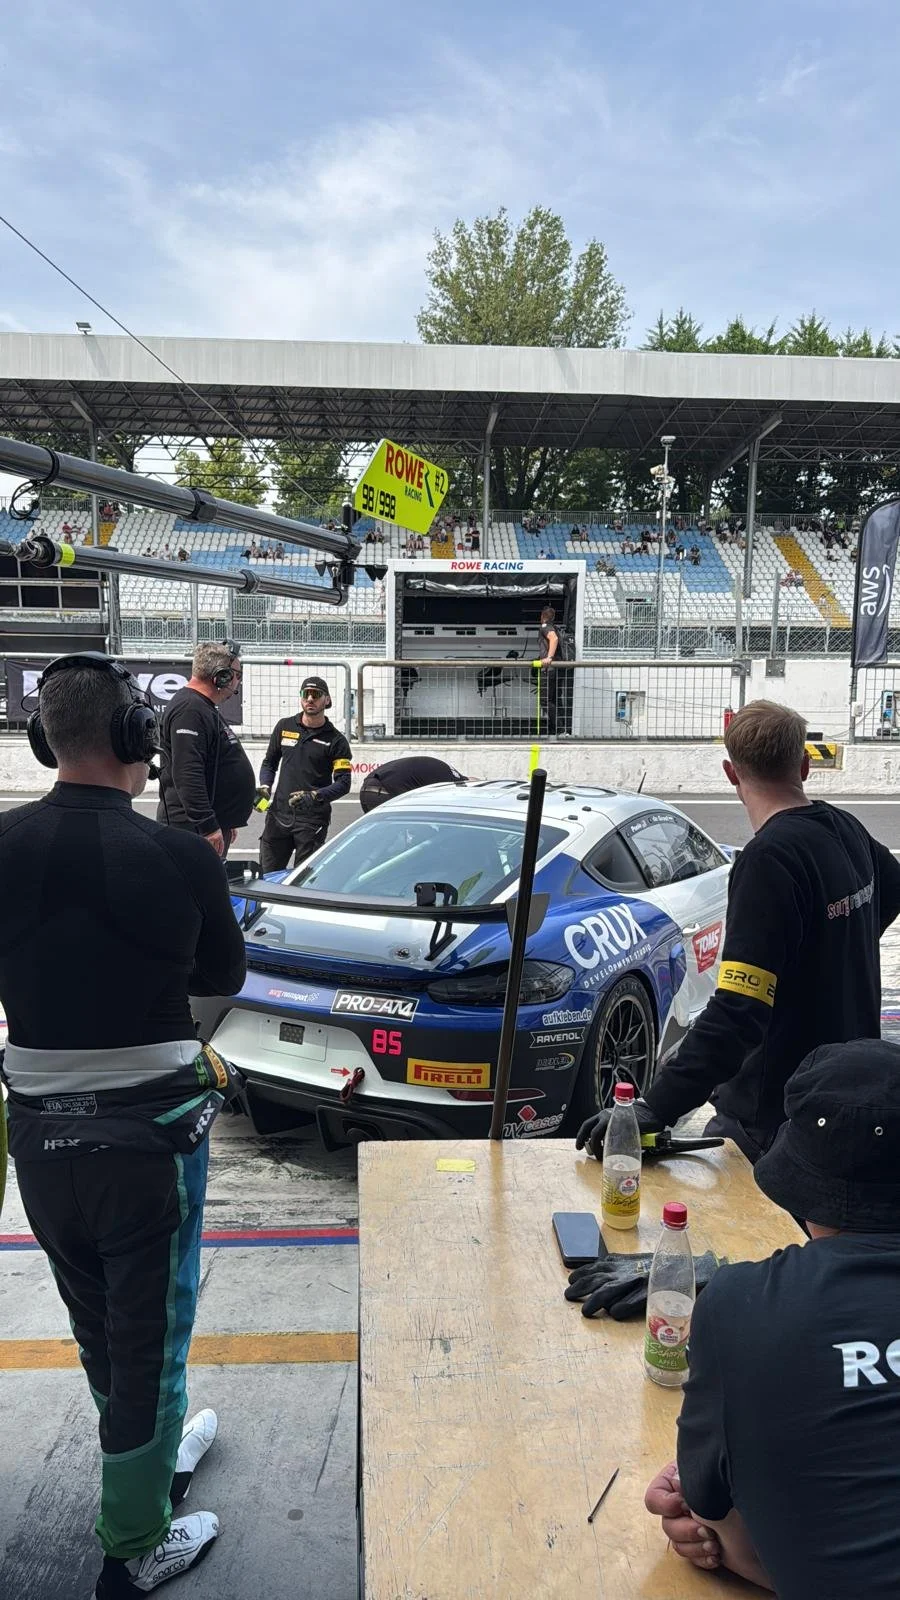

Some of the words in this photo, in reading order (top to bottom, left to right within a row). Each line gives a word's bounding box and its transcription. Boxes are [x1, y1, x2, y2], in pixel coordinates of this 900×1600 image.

[385, 442, 425, 490] ROWE
[404, 485, 423, 503] RACING
[434, 470, 446, 496] #2
[361, 483, 396, 520] 98/998
[450, 561, 482, 570] ROWE
[483, 561, 524, 571] RACING
[860, 566, 880, 616] aws
[564, 902, 648, 969] CRUX
[583, 954, 633, 989] DEVELOPMENT
[633, 943, 652, 960] STUDIO
[723, 969, 761, 988] SRO
[336, 994, 414, 1017] PRO-AM
[542, 1008, 592, 1026] aufkleben.de
[372, 1029, 402, 1055] 85
[536, 1031, 581, 1043] RAVENOL
[414, 1064, 483, 1084] PIRELLI
[152, 1559, 186, 1584] sparco
